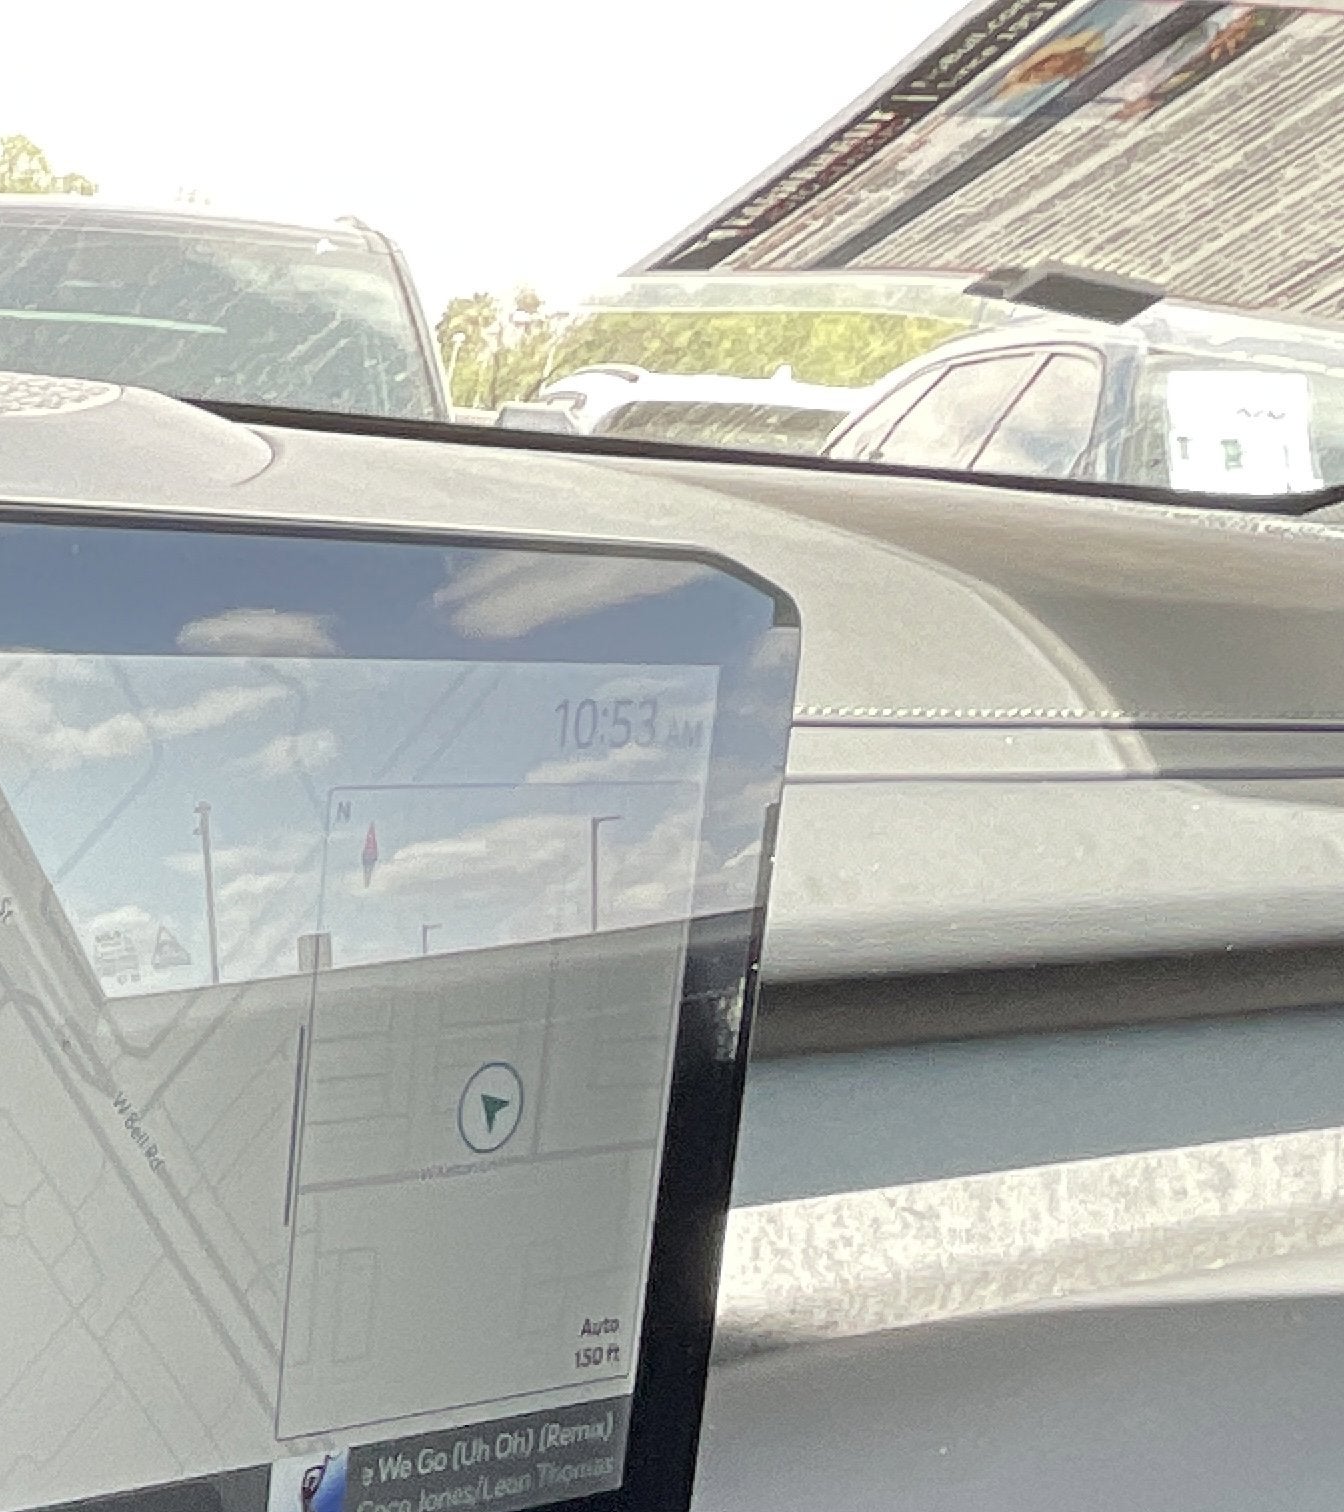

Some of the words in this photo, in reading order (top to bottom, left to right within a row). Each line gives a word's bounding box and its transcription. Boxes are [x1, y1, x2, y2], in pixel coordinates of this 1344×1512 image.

[555, 698, 658, 751] 10:53
[666, 717, 705, 749] AM
[580, 1318, 620, 1336] Auto
[575, 1346, 604, 1368] 150
[378, 1453, 413, 1483] We
[418, 1448, 448, 1476] Go
[452, 1438, 491, 1471] (Uh
[495, 1427, 534, 1459] Oh)
